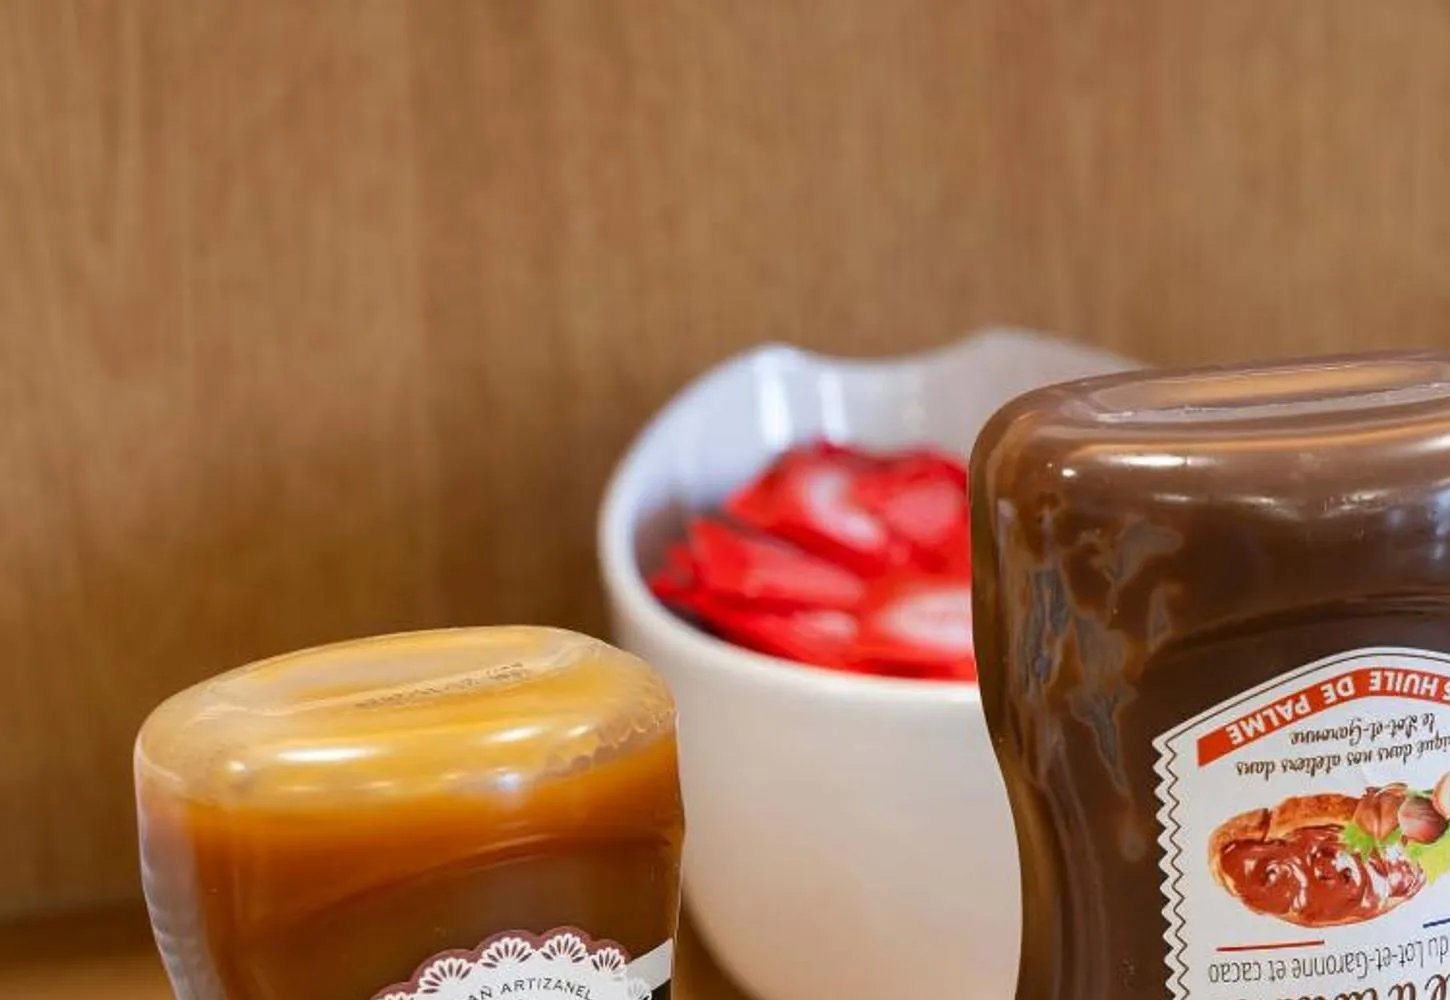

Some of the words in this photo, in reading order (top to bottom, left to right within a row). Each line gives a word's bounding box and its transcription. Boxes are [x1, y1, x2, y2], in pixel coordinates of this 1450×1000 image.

[1321, 675, 1355, 703] DE
[1369, 670, 1439, 697] HUILE
[1227, 695, 1312, 745] PALME
[1422, 712, 1437, 732] le
[1348, 749, 1374, 765] nos
[1376, 743, 1413, 761] dans
[1236, 759, 1278, 780] dans
[1281, 752, 1342, 775] ateliers
[1428, 936, 1450, 964] du
[1268, 960, 1287, 982] et
[1290, 942, 1425, 981] Lot-et-Garonne
[1208, 962, 1262, 984] cacao
